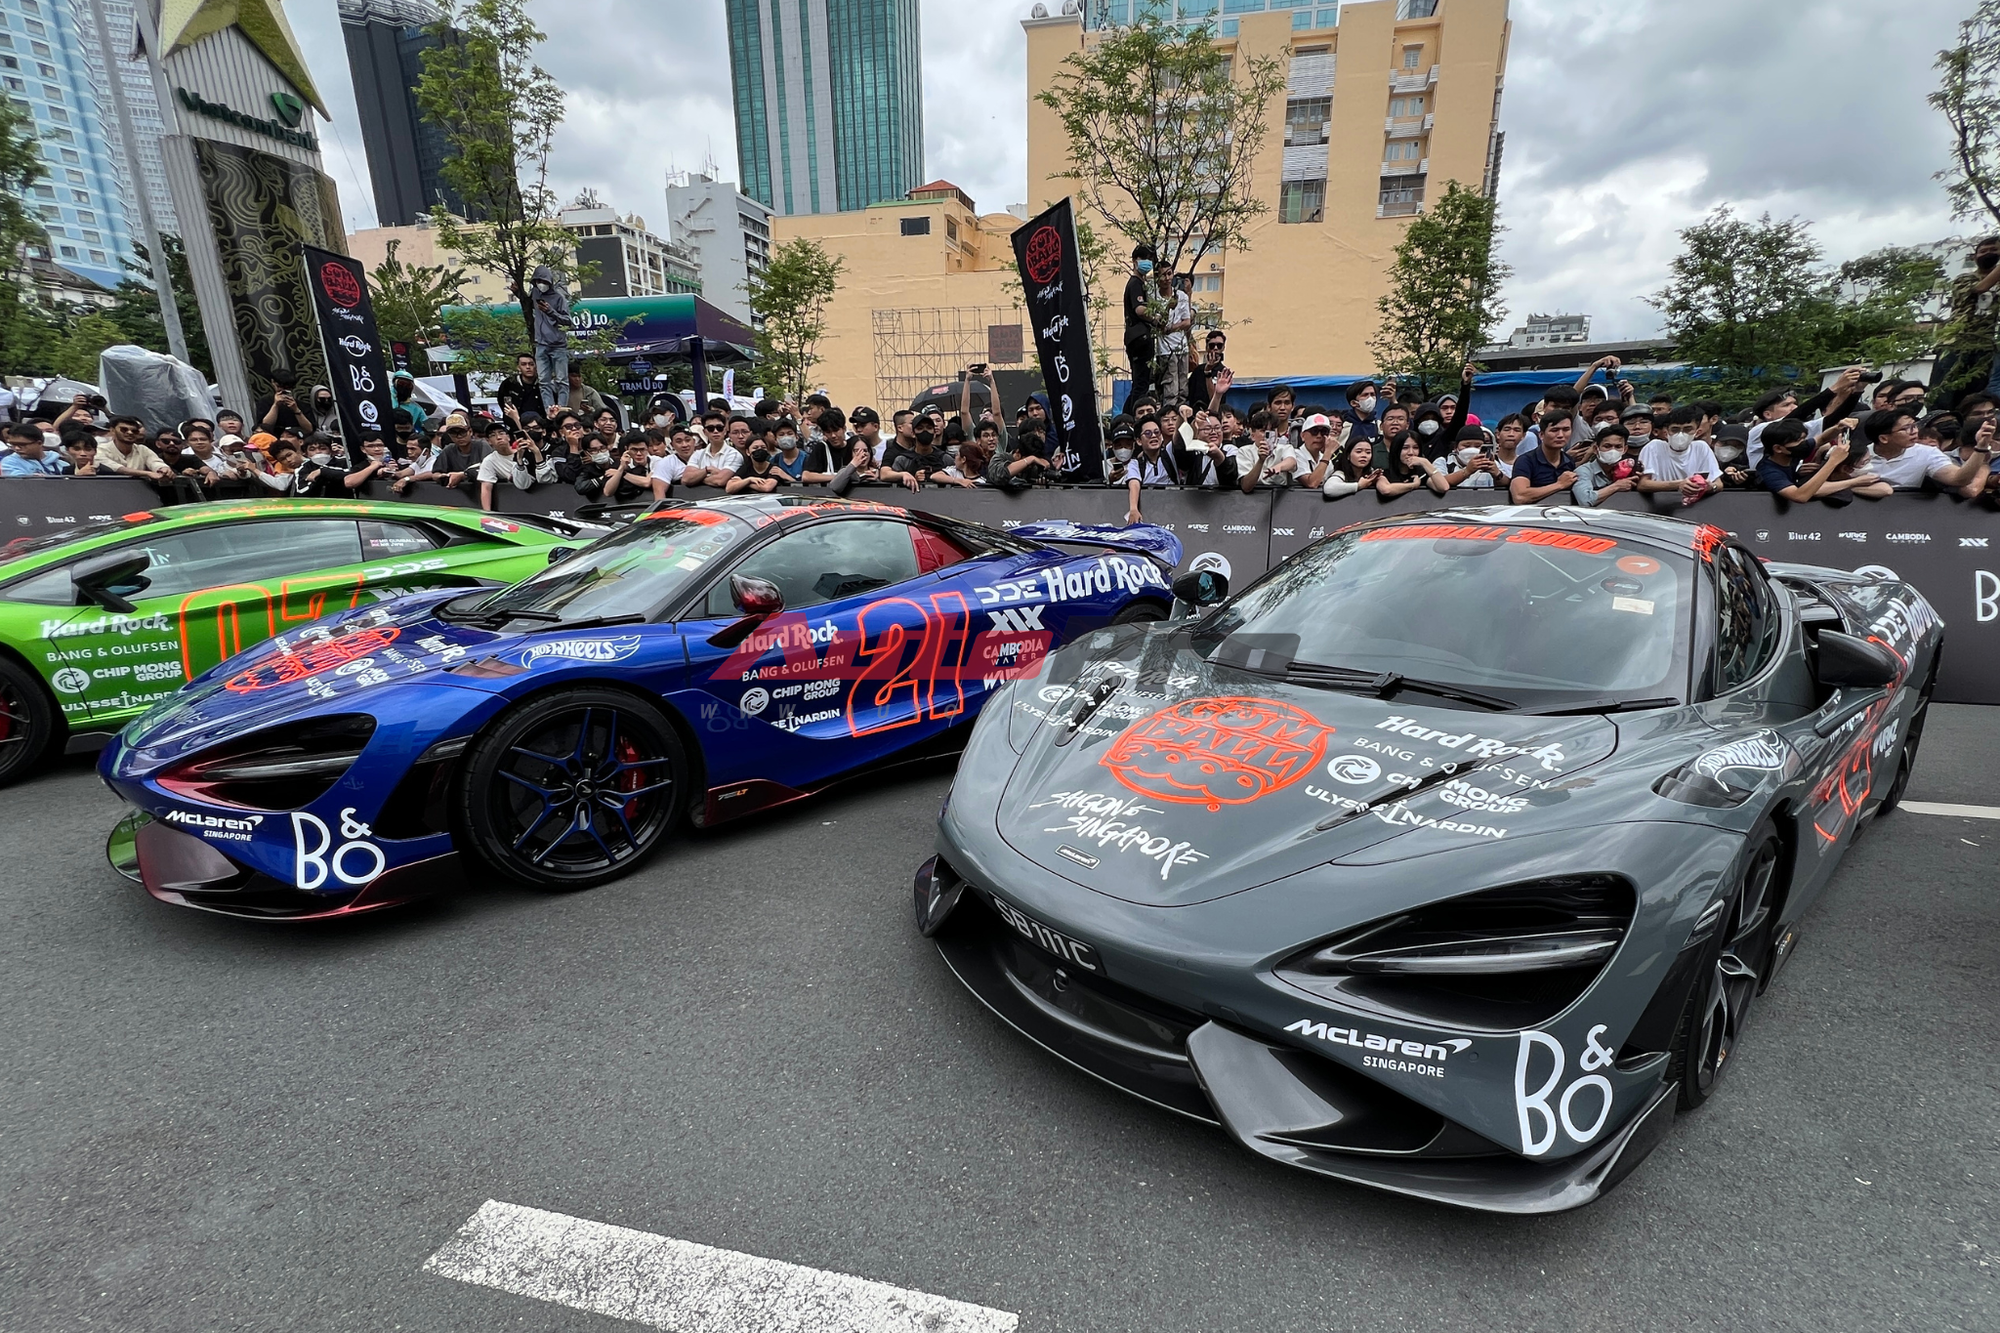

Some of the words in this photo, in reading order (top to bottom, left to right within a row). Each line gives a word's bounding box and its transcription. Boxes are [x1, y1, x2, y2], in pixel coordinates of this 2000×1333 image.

[178, 86, 320, 152] Vietcombank
[1222, 524, 1257, 532] CAMBODIA
[1273, 528, 1295, 536] XIX
[1808, 532, 1822, 541] 42
[1886, 532, 1932, 541] CAMBODIA
[1360, 525, 1508, 542] GUMBALL
[1505, 528, 1618, 554] 3000
[1958, 537, 1990, 548] XIX
[1040, 557, 1112, 603] Hard
[1109, 556, 1172, 595] Rock
[40, 616, 106, 639] Hard
[985, 604, 1046, 639] XIX
[739, 625, 790, 654] Hard
[982, 638, 1044, 660] CAMBODIA
[46, 647, 92, 662] BANG
[97, 647, 108, 658] &
[110, 640, 179, 656] OLUFSEN
[530, 643, 553, 659] HOT
[990, 652, 1037, 666] WATER
[92, 665, 131, 679] CHIP
[133, 660, 182, 675] MONG
[742, 665, 778, 682] BANG
[781, 664, 790, 675] &
[792, 654, 845, 674] OLUFSEN
[846, 590, 971, 738] 21
[135, 669, 183, 682] GROUP
[772, 683, 803, 699] CHIP
[803, 677, 841, 693] MONG
[803, 686, 840, 701] GROUP
[1112, 686, 1175, 702] OLUFSEN
[61, 696, 121, 712] ULYSSE
[1102, 702, 1150, 715] MONG
[794, 708, 841, 727] NARDIN
[1374, 715, 1477, 749] Hard
[1353, 737, 1416, 762] BANG
[1419, 756, 1434, 769] &
[1029, 789, 1138, 817] SAIGON
[1438, 790, 1525, 814] GROUP
[1444, 779, 1531, 808] MONG
[165, 810, 254, 832] McLaren
[1401, 810, 1508, 840] NARDIN
[202, 829, 253, 842] SINGAPORE
[1043, 816, 1210, 881] SINGAPORE
[1060, 847, 1097, 864] McLaren
[1282, 1018, 1448, 1061] McLaren
[1362, 1055, 1446, 1079] SINGAPORE
